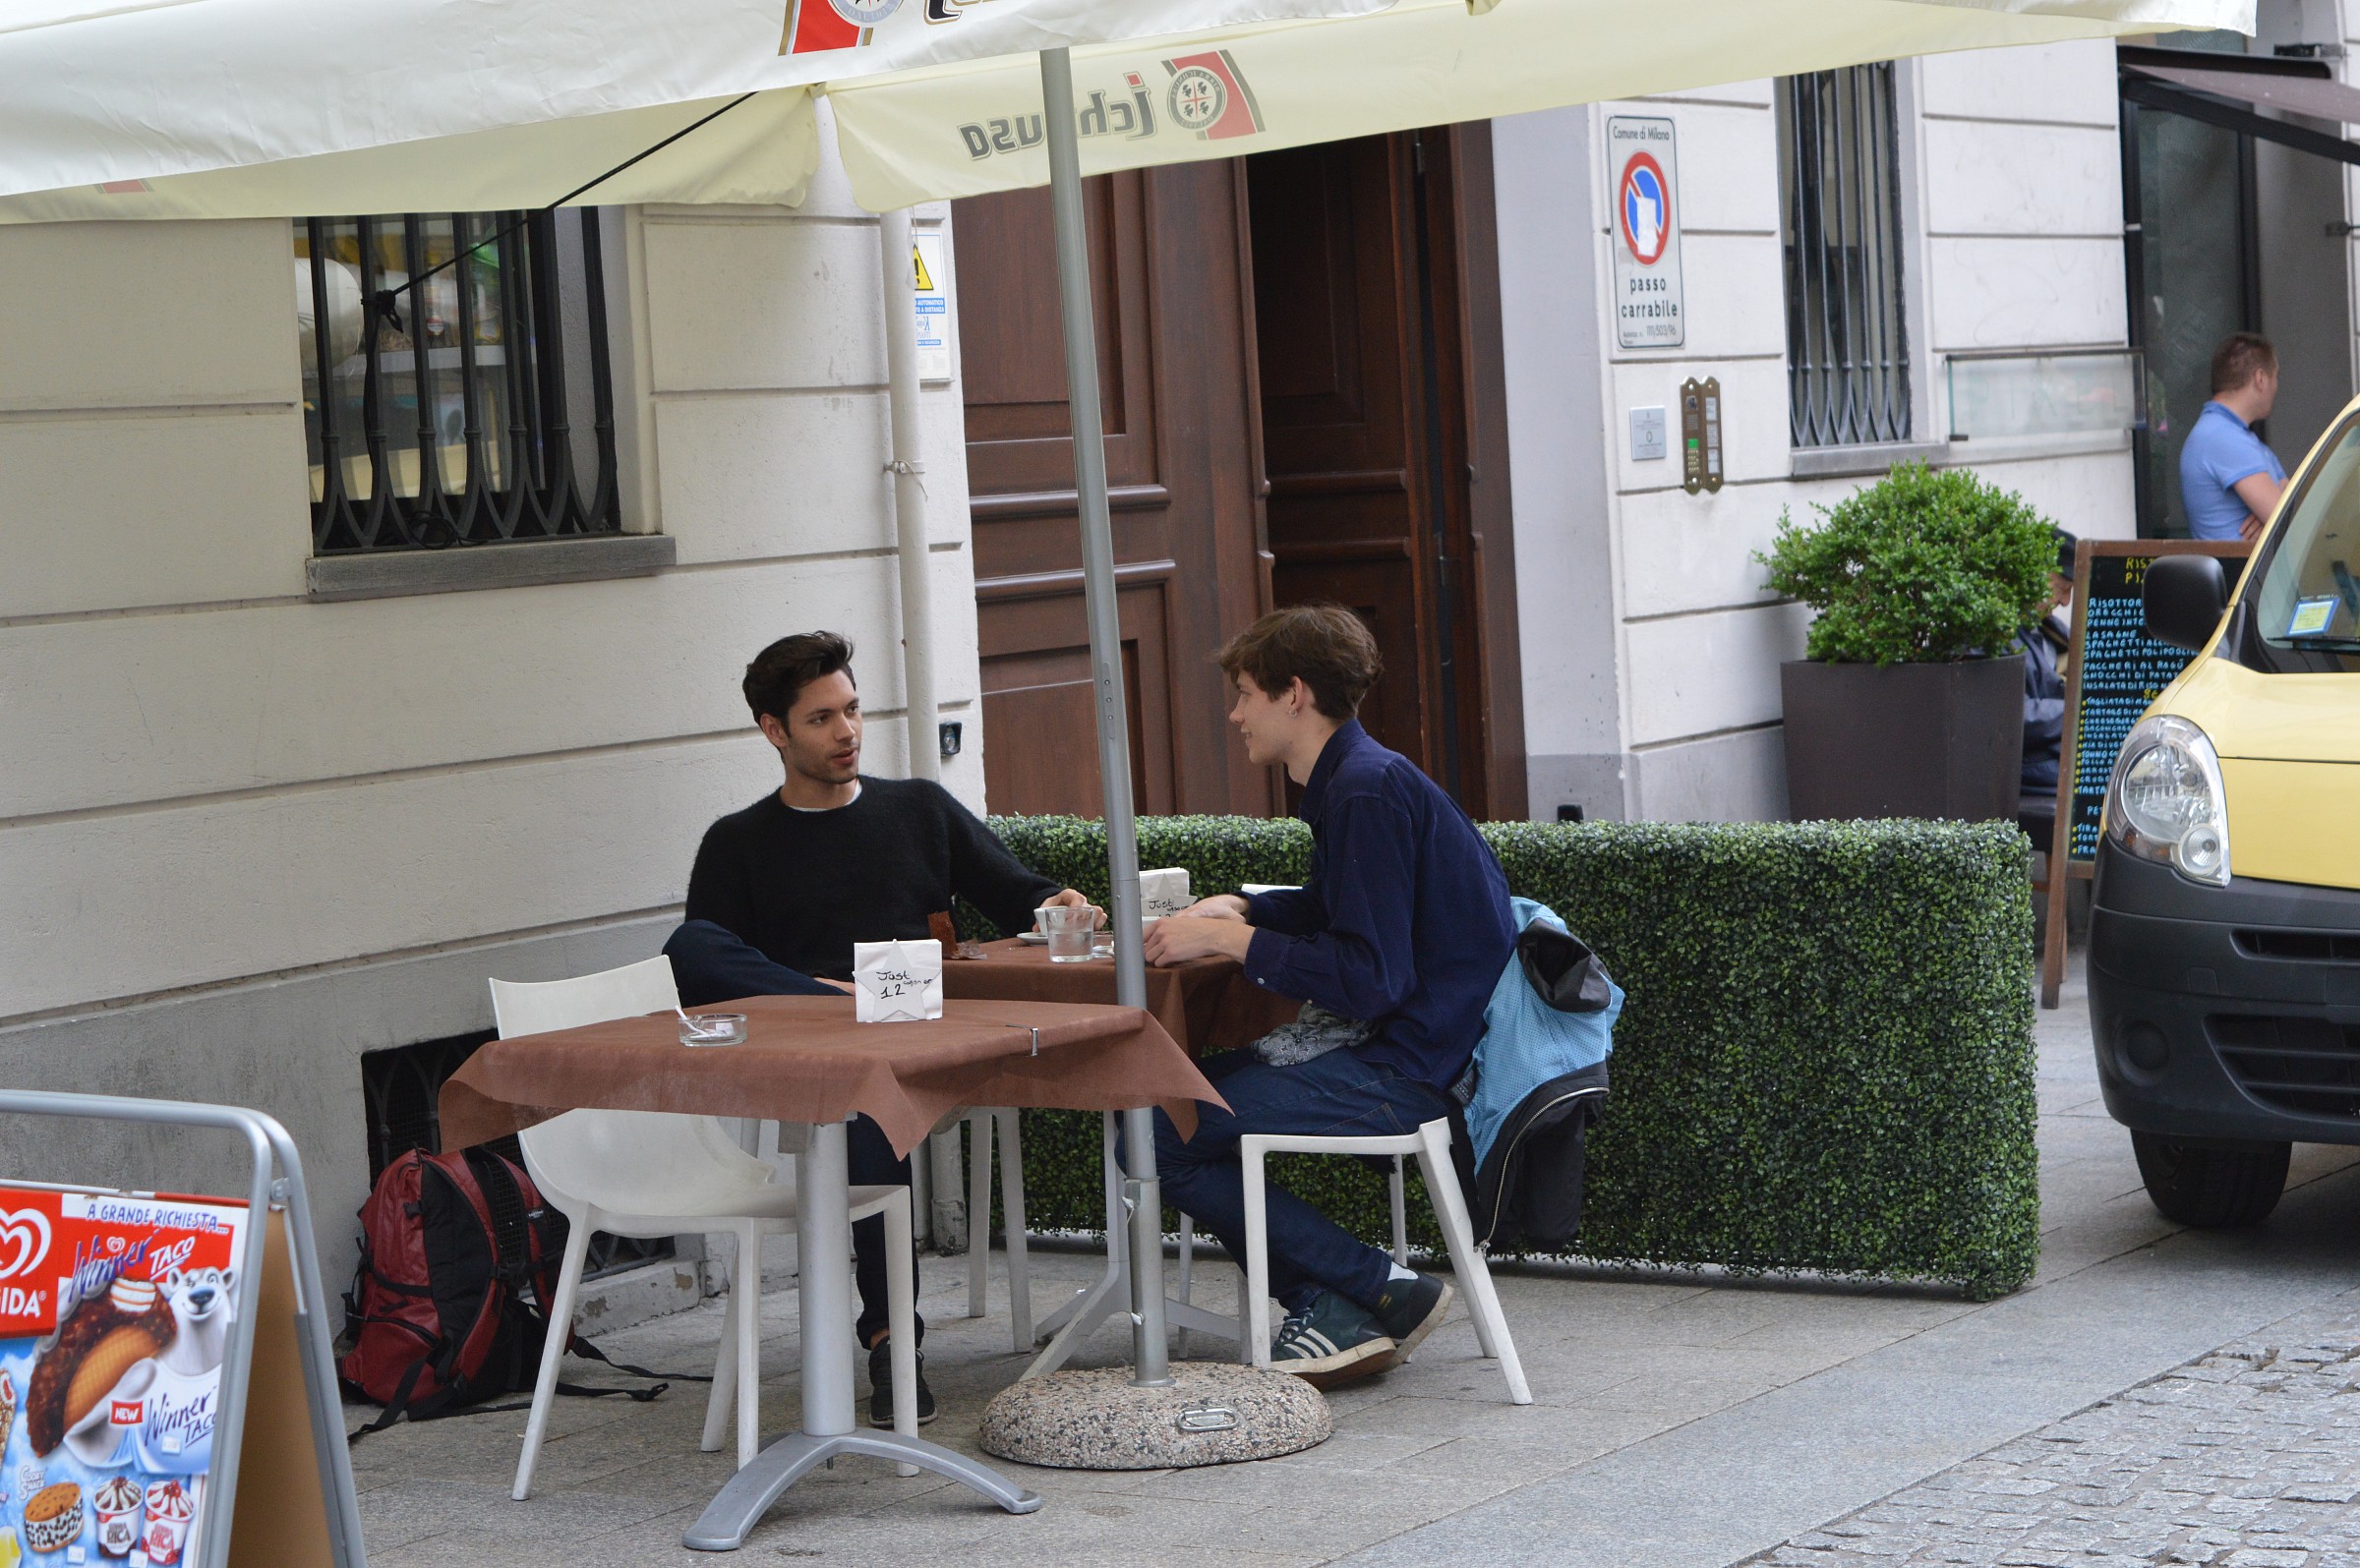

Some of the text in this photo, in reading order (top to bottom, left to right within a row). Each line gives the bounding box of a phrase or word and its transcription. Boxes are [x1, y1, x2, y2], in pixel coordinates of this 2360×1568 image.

[1613, 126, 1670, 141] Comune di Milano
[1629, 277, 1666, 296] passo
[1621, 300, 1678, 318] carrabile
[2125, 556, 2155, 569] RIST
[2124, 571, 2144, 584] PI
[2087, 608, 2146, 617] ORECCHIE
[2087, 617, 2146, 628] PENNE INTE
[2086, 630, 2137, 640] LASAGNE
[2139, 661, 2153, 670] AL
[2082, 750, 2108, 759] TONNO
[2078, 785, 2106, 795] TARTA
[2077, 822, 2098, 834] TIRA
[2077, 833, 2098, 842] TORT
[2077, 844, 2096, 855] FRA
[1148, 898, 1173, 909] Just
[876, 969, 911, 981] Just
[87, 1203, 96, 1218] A
[100, 1205, 150, 1223] GRANDE
[149, 1236, 196, 1277] TACO
[0, 1287, 41, 1318] IDA
[114, 1407, 141, 1423] NEW
[145, 1390, 214, 1447] Winner
